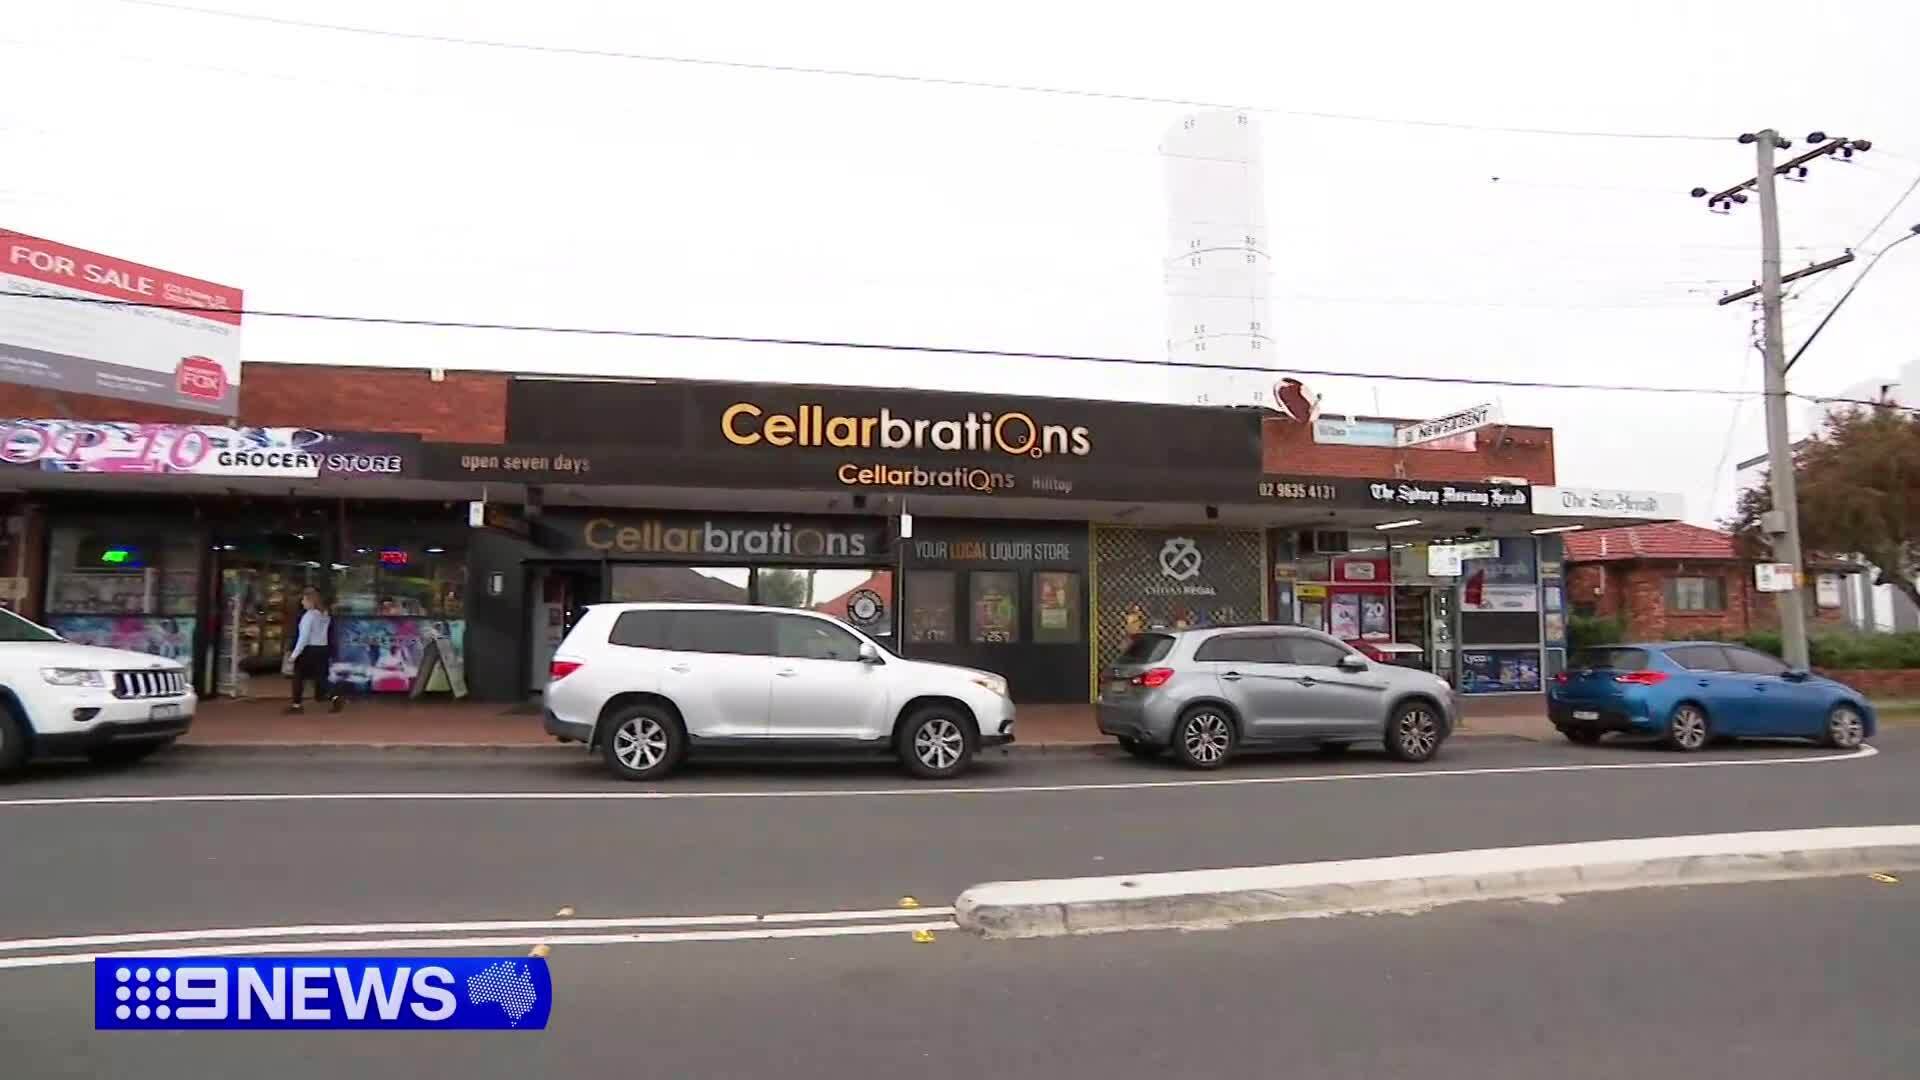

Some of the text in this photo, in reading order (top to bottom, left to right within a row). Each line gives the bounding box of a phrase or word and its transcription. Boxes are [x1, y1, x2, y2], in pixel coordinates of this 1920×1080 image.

[9, 246, 75, 277] FOR
[82, 264, 155, 296] SALE
[183, 373, 219, 391] FOX
[218, 451, 401, 473] GROCERY STORE
[461, 454, 591, 473] open seven days
[1259, 483, 1274, 496] 02
[1308, 485, 1336, 499] 4131
[1370, 483, 1526, 507] The Sydney Morning Herald
[1561, 491, 1585, 508] The
[915, 541, 1072, 560] YOUR LOCAL LIQUOR STORE
